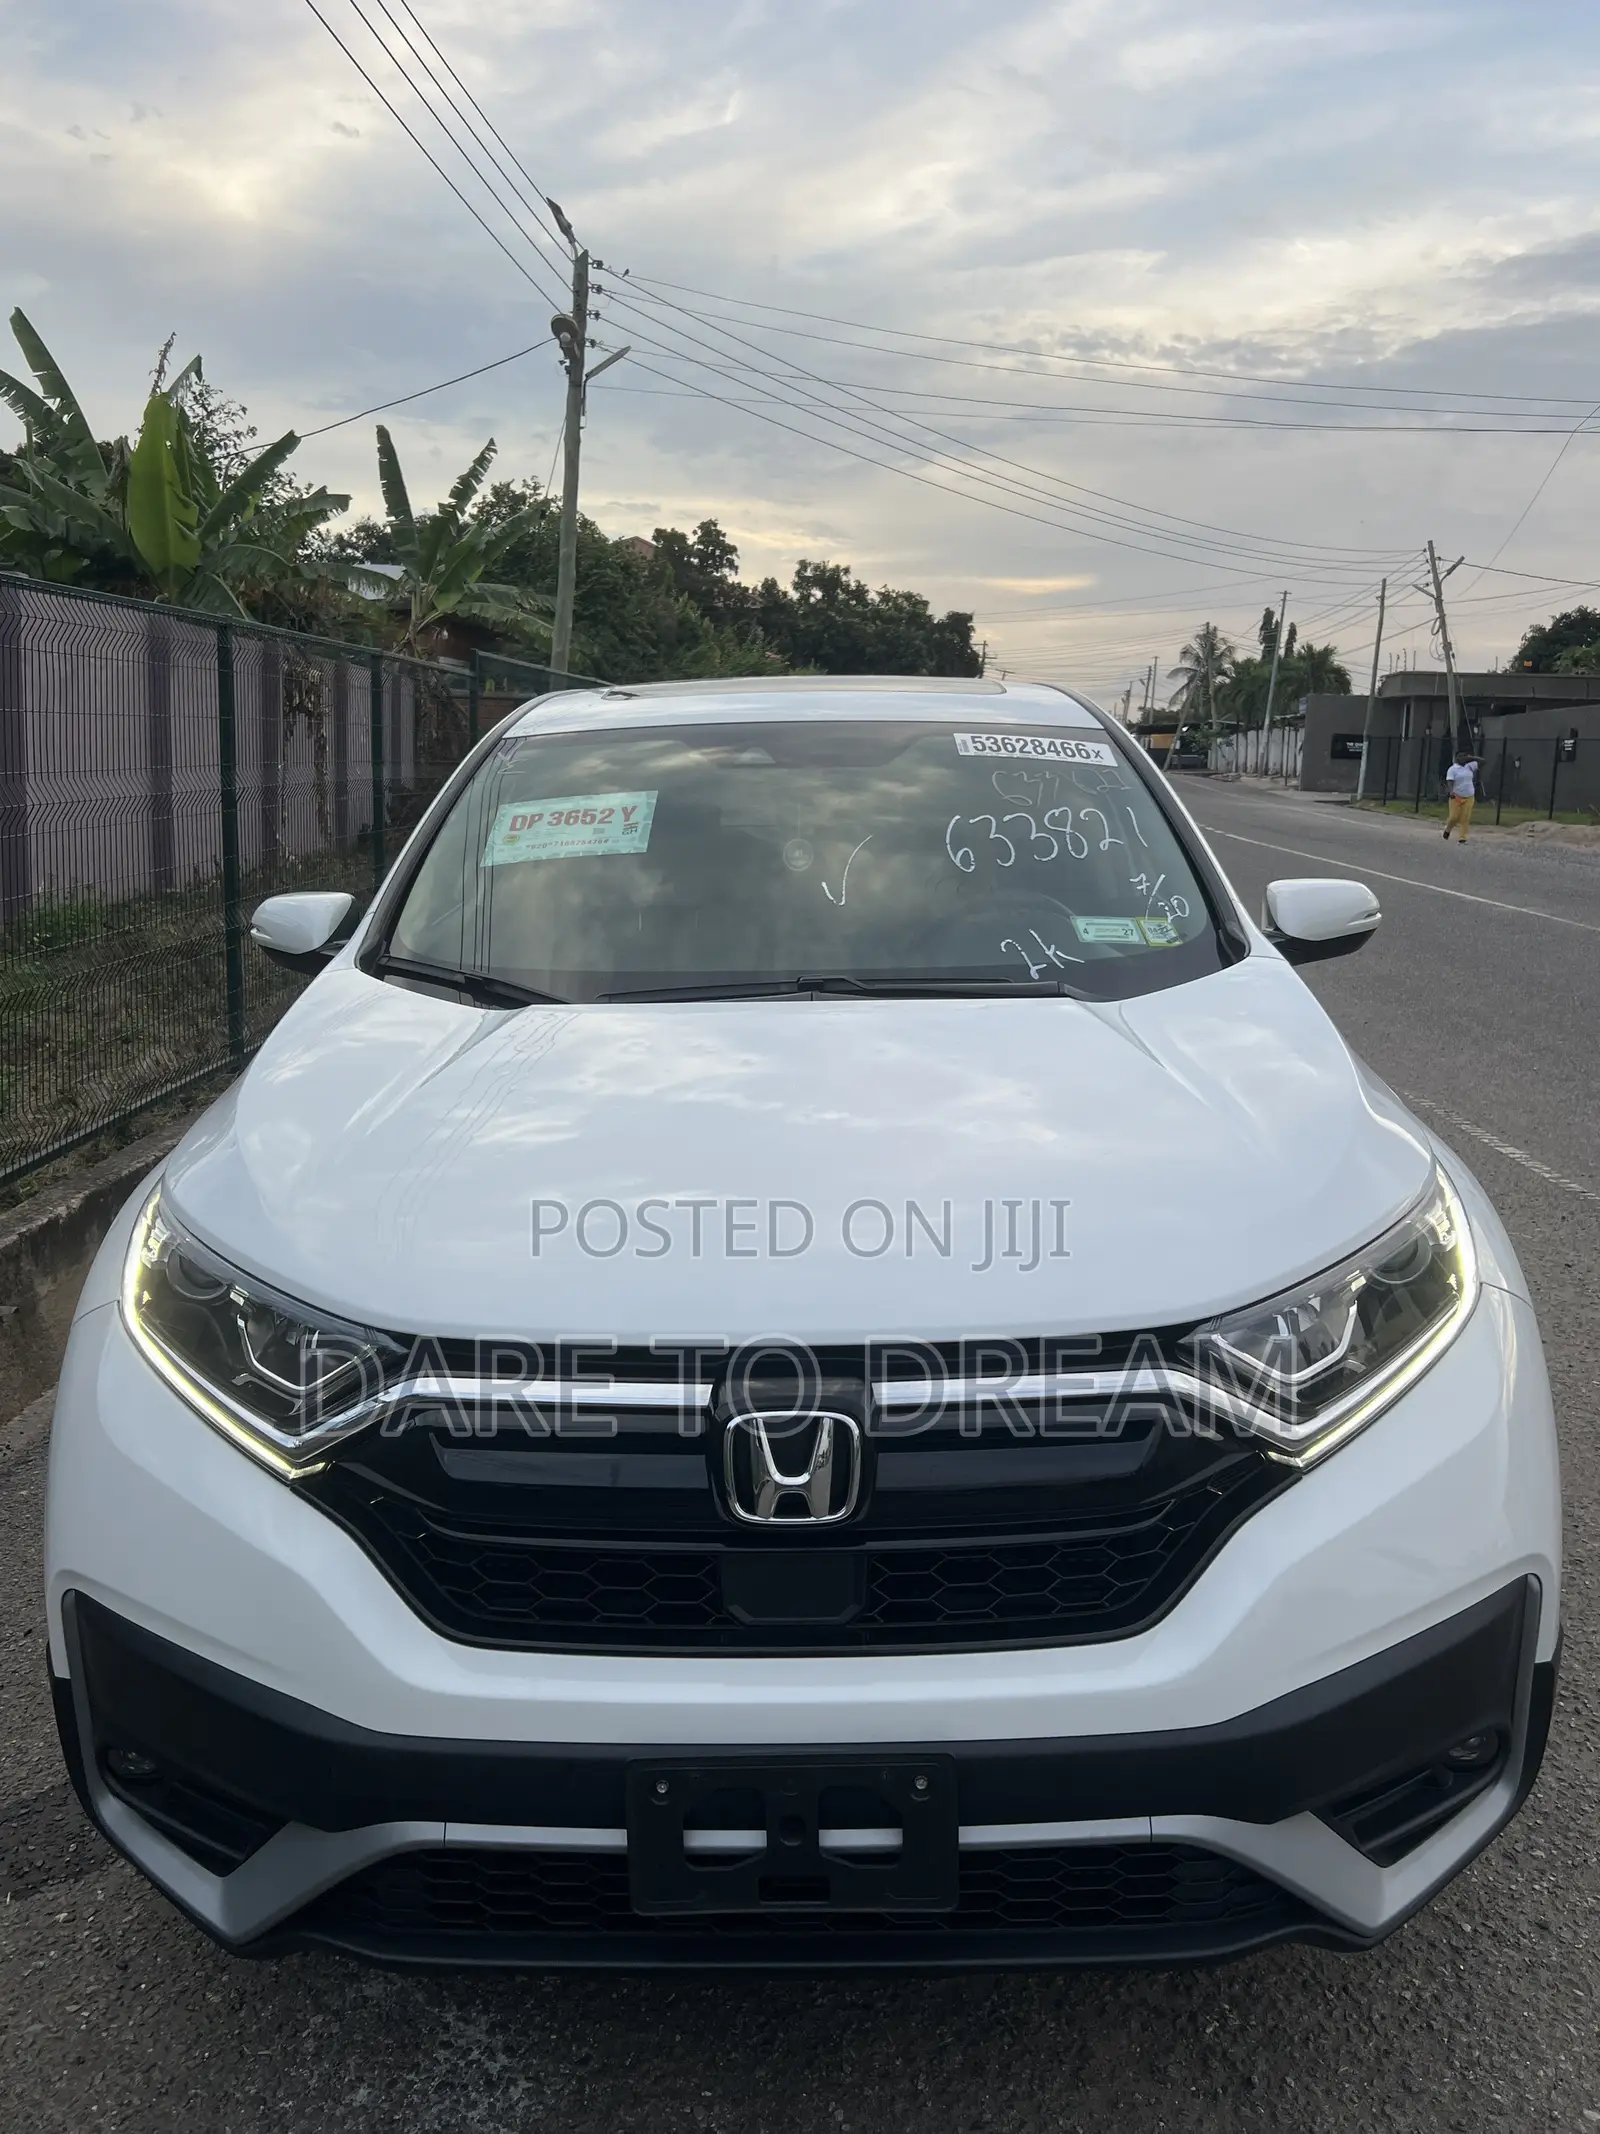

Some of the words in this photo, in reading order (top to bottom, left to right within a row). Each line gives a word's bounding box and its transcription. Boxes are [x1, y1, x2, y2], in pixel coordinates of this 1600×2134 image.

[508, 812, 545, 832] DP
[547, 807, 616, 827] 3652
[621, 805, 638, 823] Y
[945, 806, 1148, 873] 633821
[1121, 927, 1135, 937] 27
